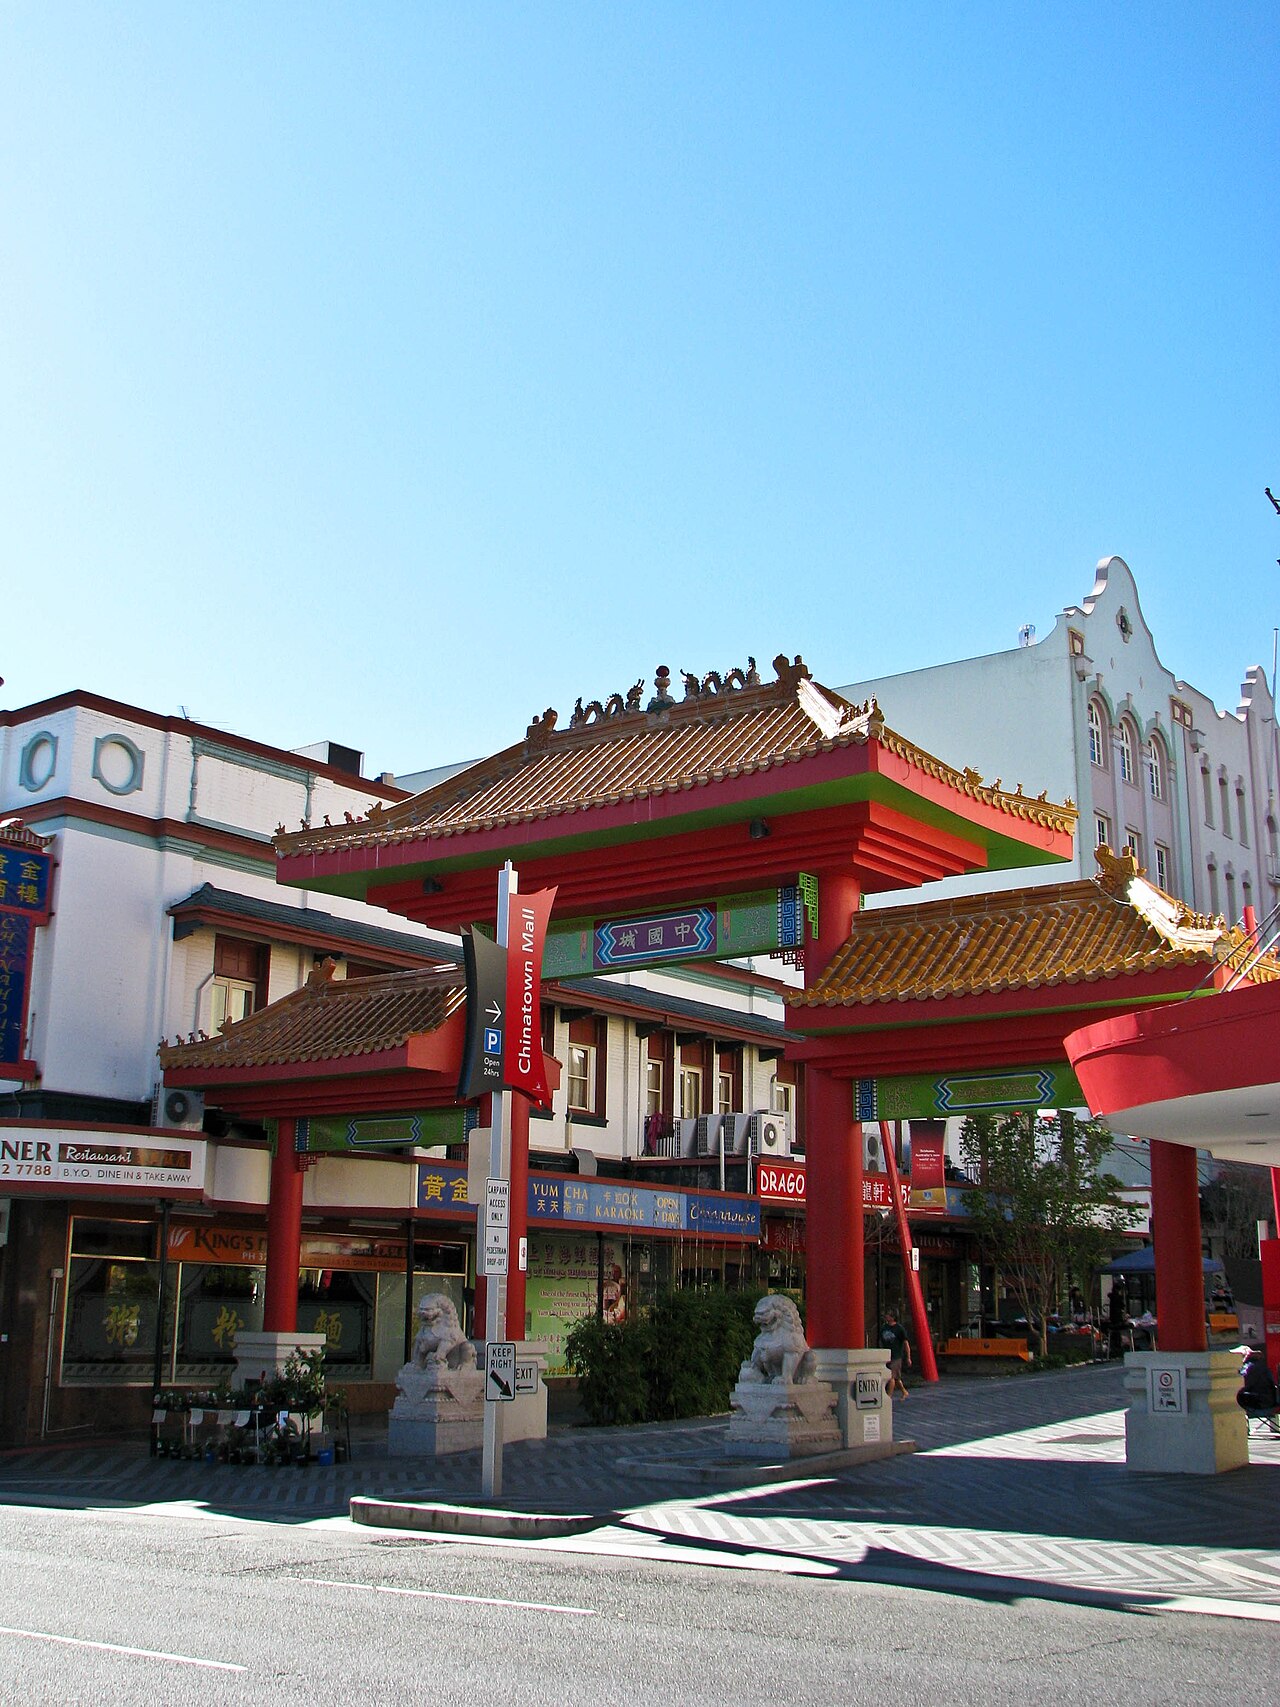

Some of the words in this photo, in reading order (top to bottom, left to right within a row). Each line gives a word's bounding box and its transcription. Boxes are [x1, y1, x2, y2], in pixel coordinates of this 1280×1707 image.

[522, 908, 535, 952] Mall
[518, 961, 534, 1074] Chinatown
[488, 1033, 498, 1046] P
[483, 1057, 500, 1067] Open
[483, 1067, 500, 1077] 24hrs
[1, 1141, 52, 1162] NER
[66, 1146, 132, 1162] Restaurant
[2, 1164, 10, 1174] 2
[16, 1164, 52, 1176] 7788
[63, 1169, 92, 1178] B.Y.O.
[97, 1170, 121, 1179] DINE
[123, 1171, 134, 1180] IN
[136, 1172, 142, 1180] &
[144, 1172, 166, 1182] TAKE
[167, 1174, 192, 1184] AWAY
[760, 1169, 805, 1195] DRAGO
[488, 1185, 508, 1195] CARPARK
[532, 1183, 559, 1197] YUM
[564, 1185, 589, 1200] CHA
[489, 1199, 506, 1208] ACCESS
[656, 1197, 679, 1210] OPEN
[491, 1212, 503, 1221] ONLY
[595, 1206, 645, 1221] KARAOKE
[661, 1211, 681, 1224] DAYS
[194, 1228, 254, 1258] KING'S
[494, 1235, 500, 1243] NO
[242, 1252, 256, 1260] PH
[486, 1246, 507, 1255] PEDESTRIAN
[492, 1348, 512, 1357] KEEP
[490, 1359, 512, 1369] RIGHT
[515, 1368, 533, 1379] EXIT
[858, 1379, 880, 1393] ENTRY
